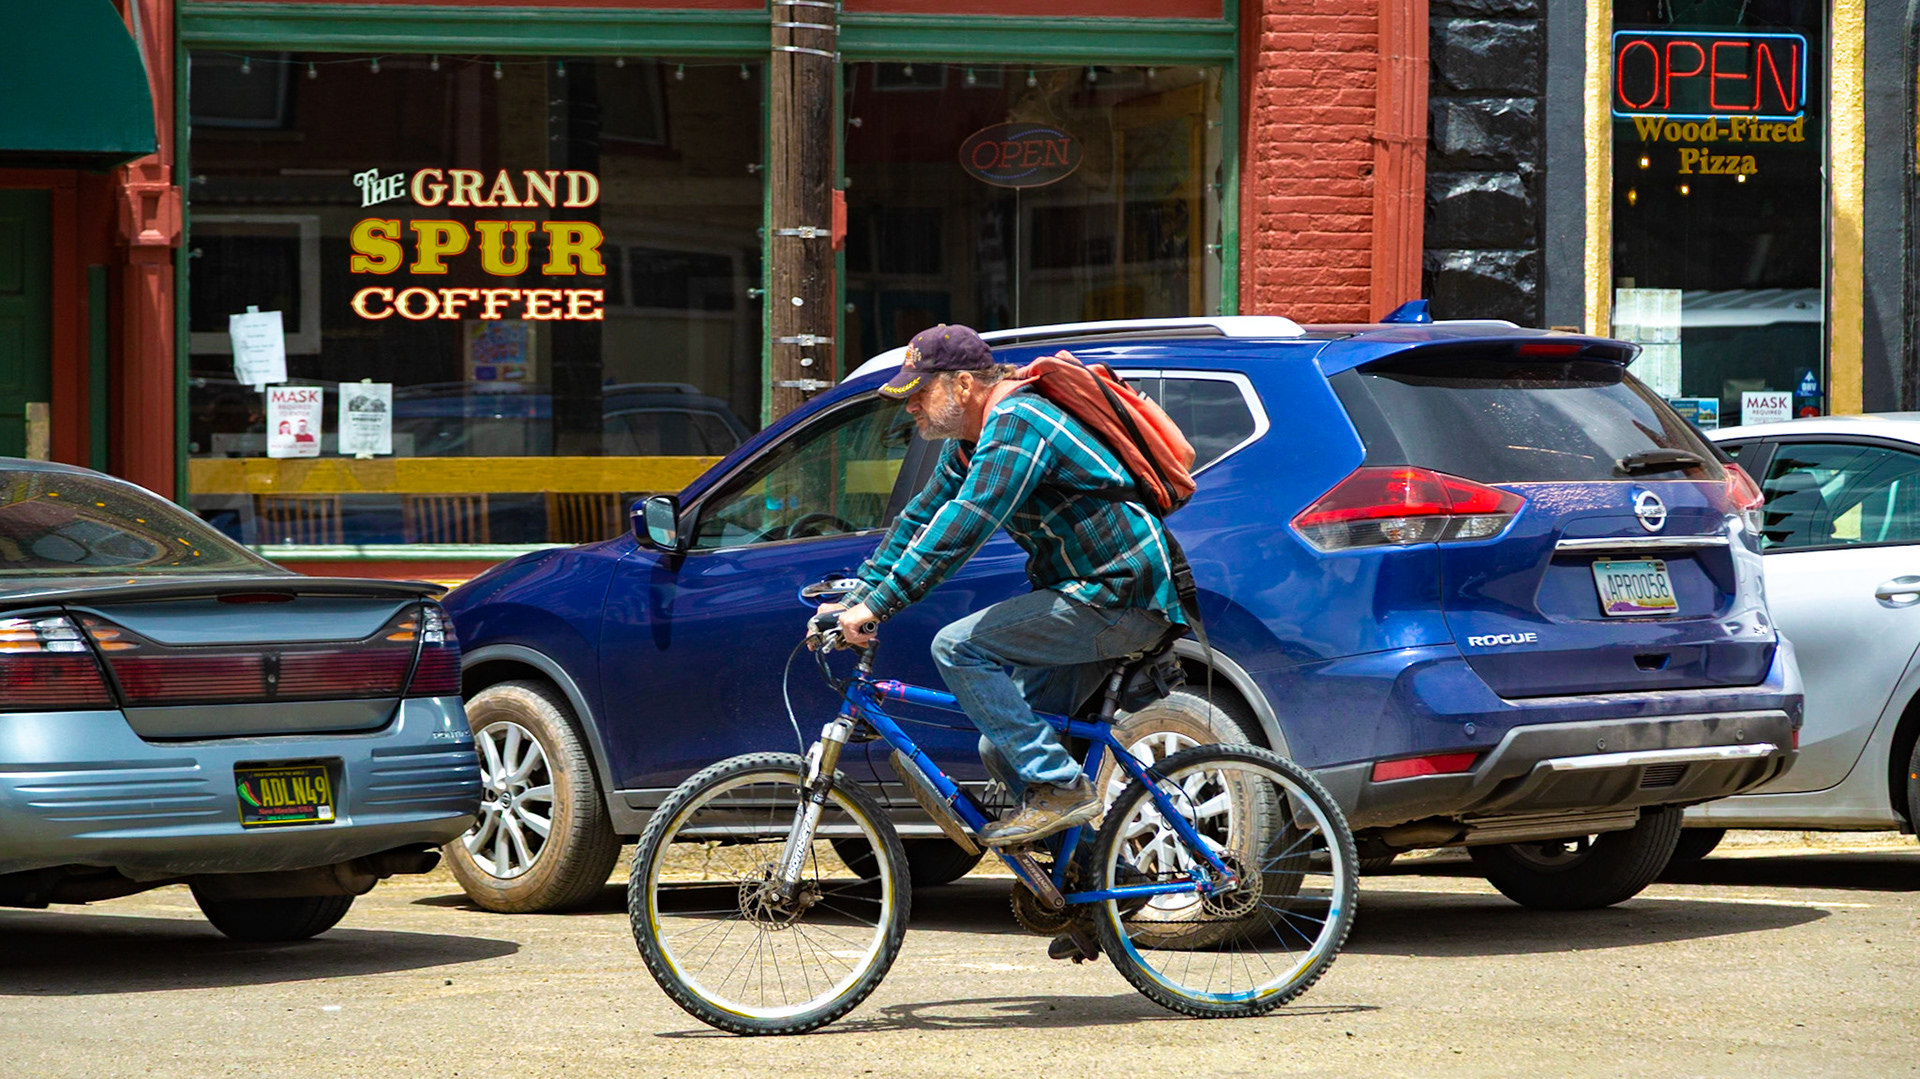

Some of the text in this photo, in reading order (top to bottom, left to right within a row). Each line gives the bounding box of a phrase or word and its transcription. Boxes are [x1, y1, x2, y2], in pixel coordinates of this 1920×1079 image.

[1618, 40, 1797, 112] OPEN
[1632, 116, 1805, 142] Wood-Fired
[972, 138, 1071, 170] OPEN
[1678, 148, 1758, 174] Pizza
[410, 168, 600, 208] GRAND
[350, 217, 606, 276] SPUR
[350, 287, 604, 320] COFFEE
[272, 390, 318, 403] MASK
[1746, 397, 1788, 409] MASK
[1467, 632, 1538, 647] ROGUE
[260, 776, 327, 807] ADLN49
